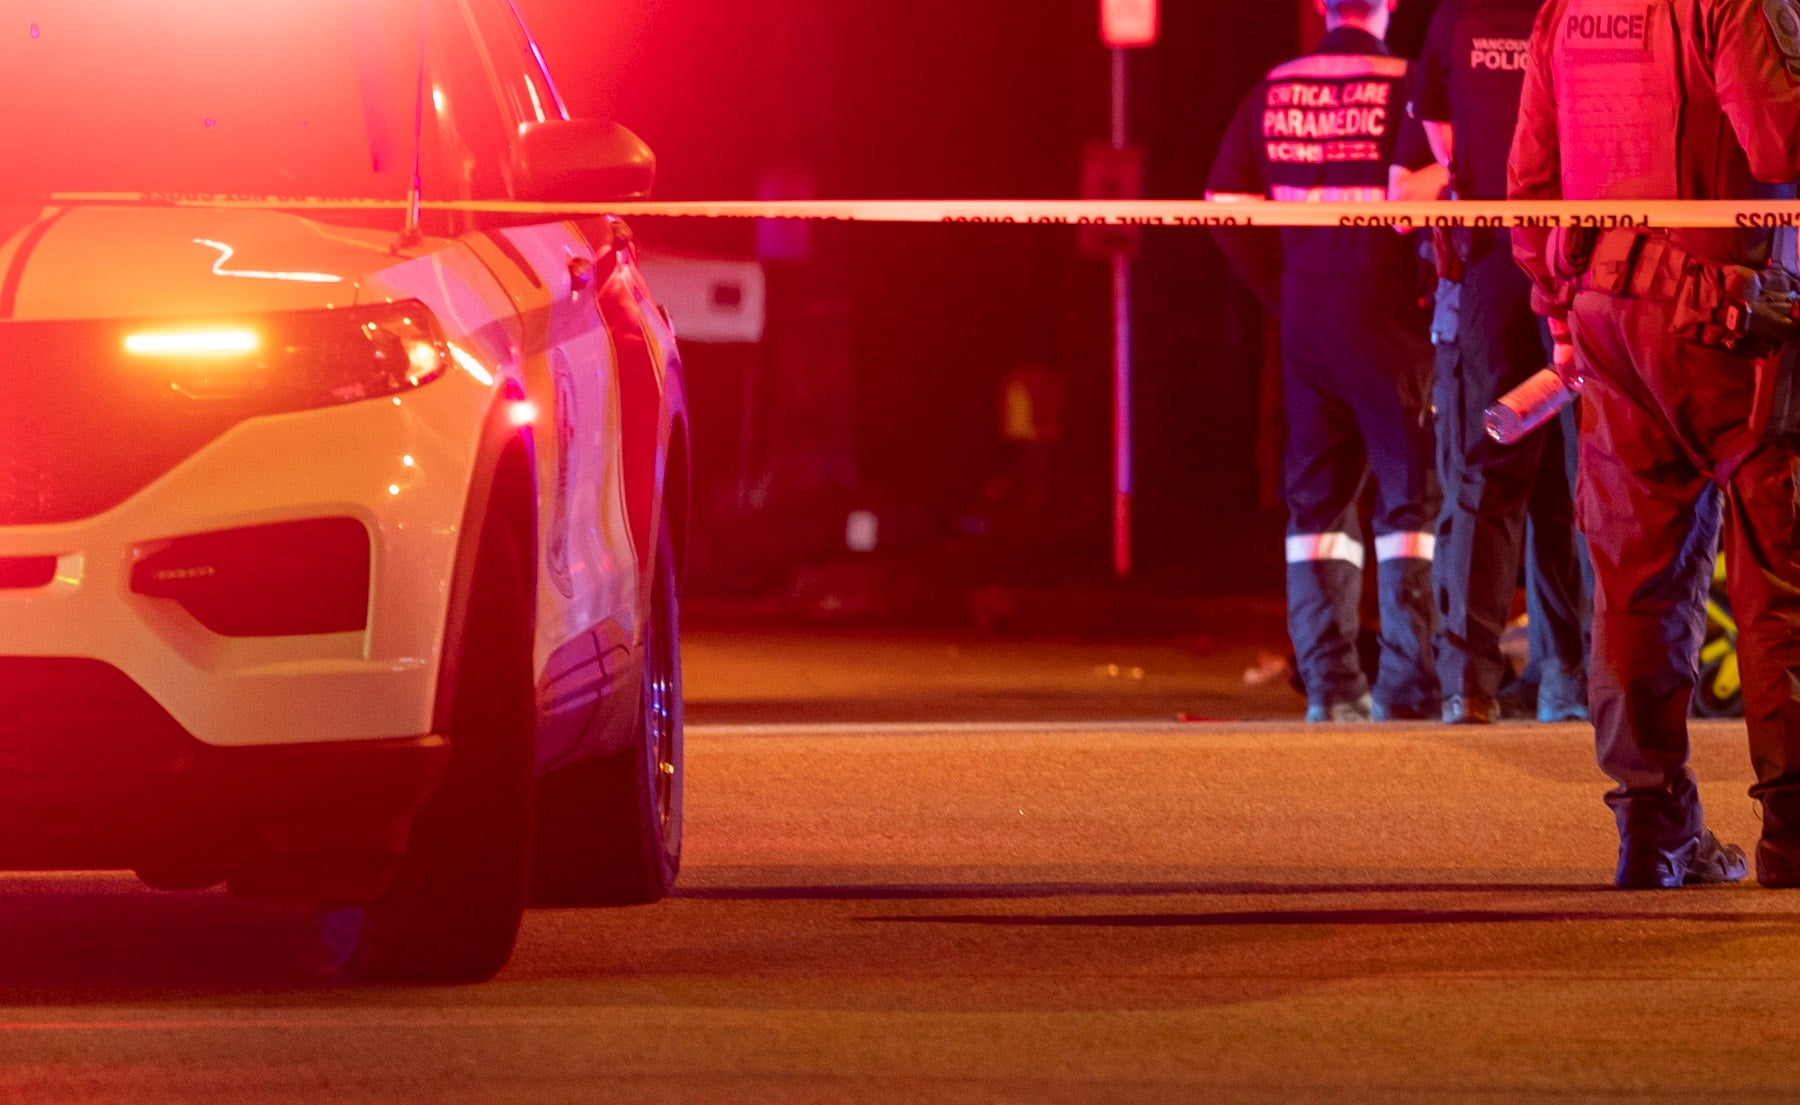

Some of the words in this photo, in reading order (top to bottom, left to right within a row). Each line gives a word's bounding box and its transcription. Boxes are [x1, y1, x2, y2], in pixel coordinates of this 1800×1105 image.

[1566, 14, 1644, 39] POLICE
[1470, 50, 1529, 70] POLIC
[1341, 82, 1391, 106] CARE
[1264, 106, 1386, 138] PARAMEDIC
